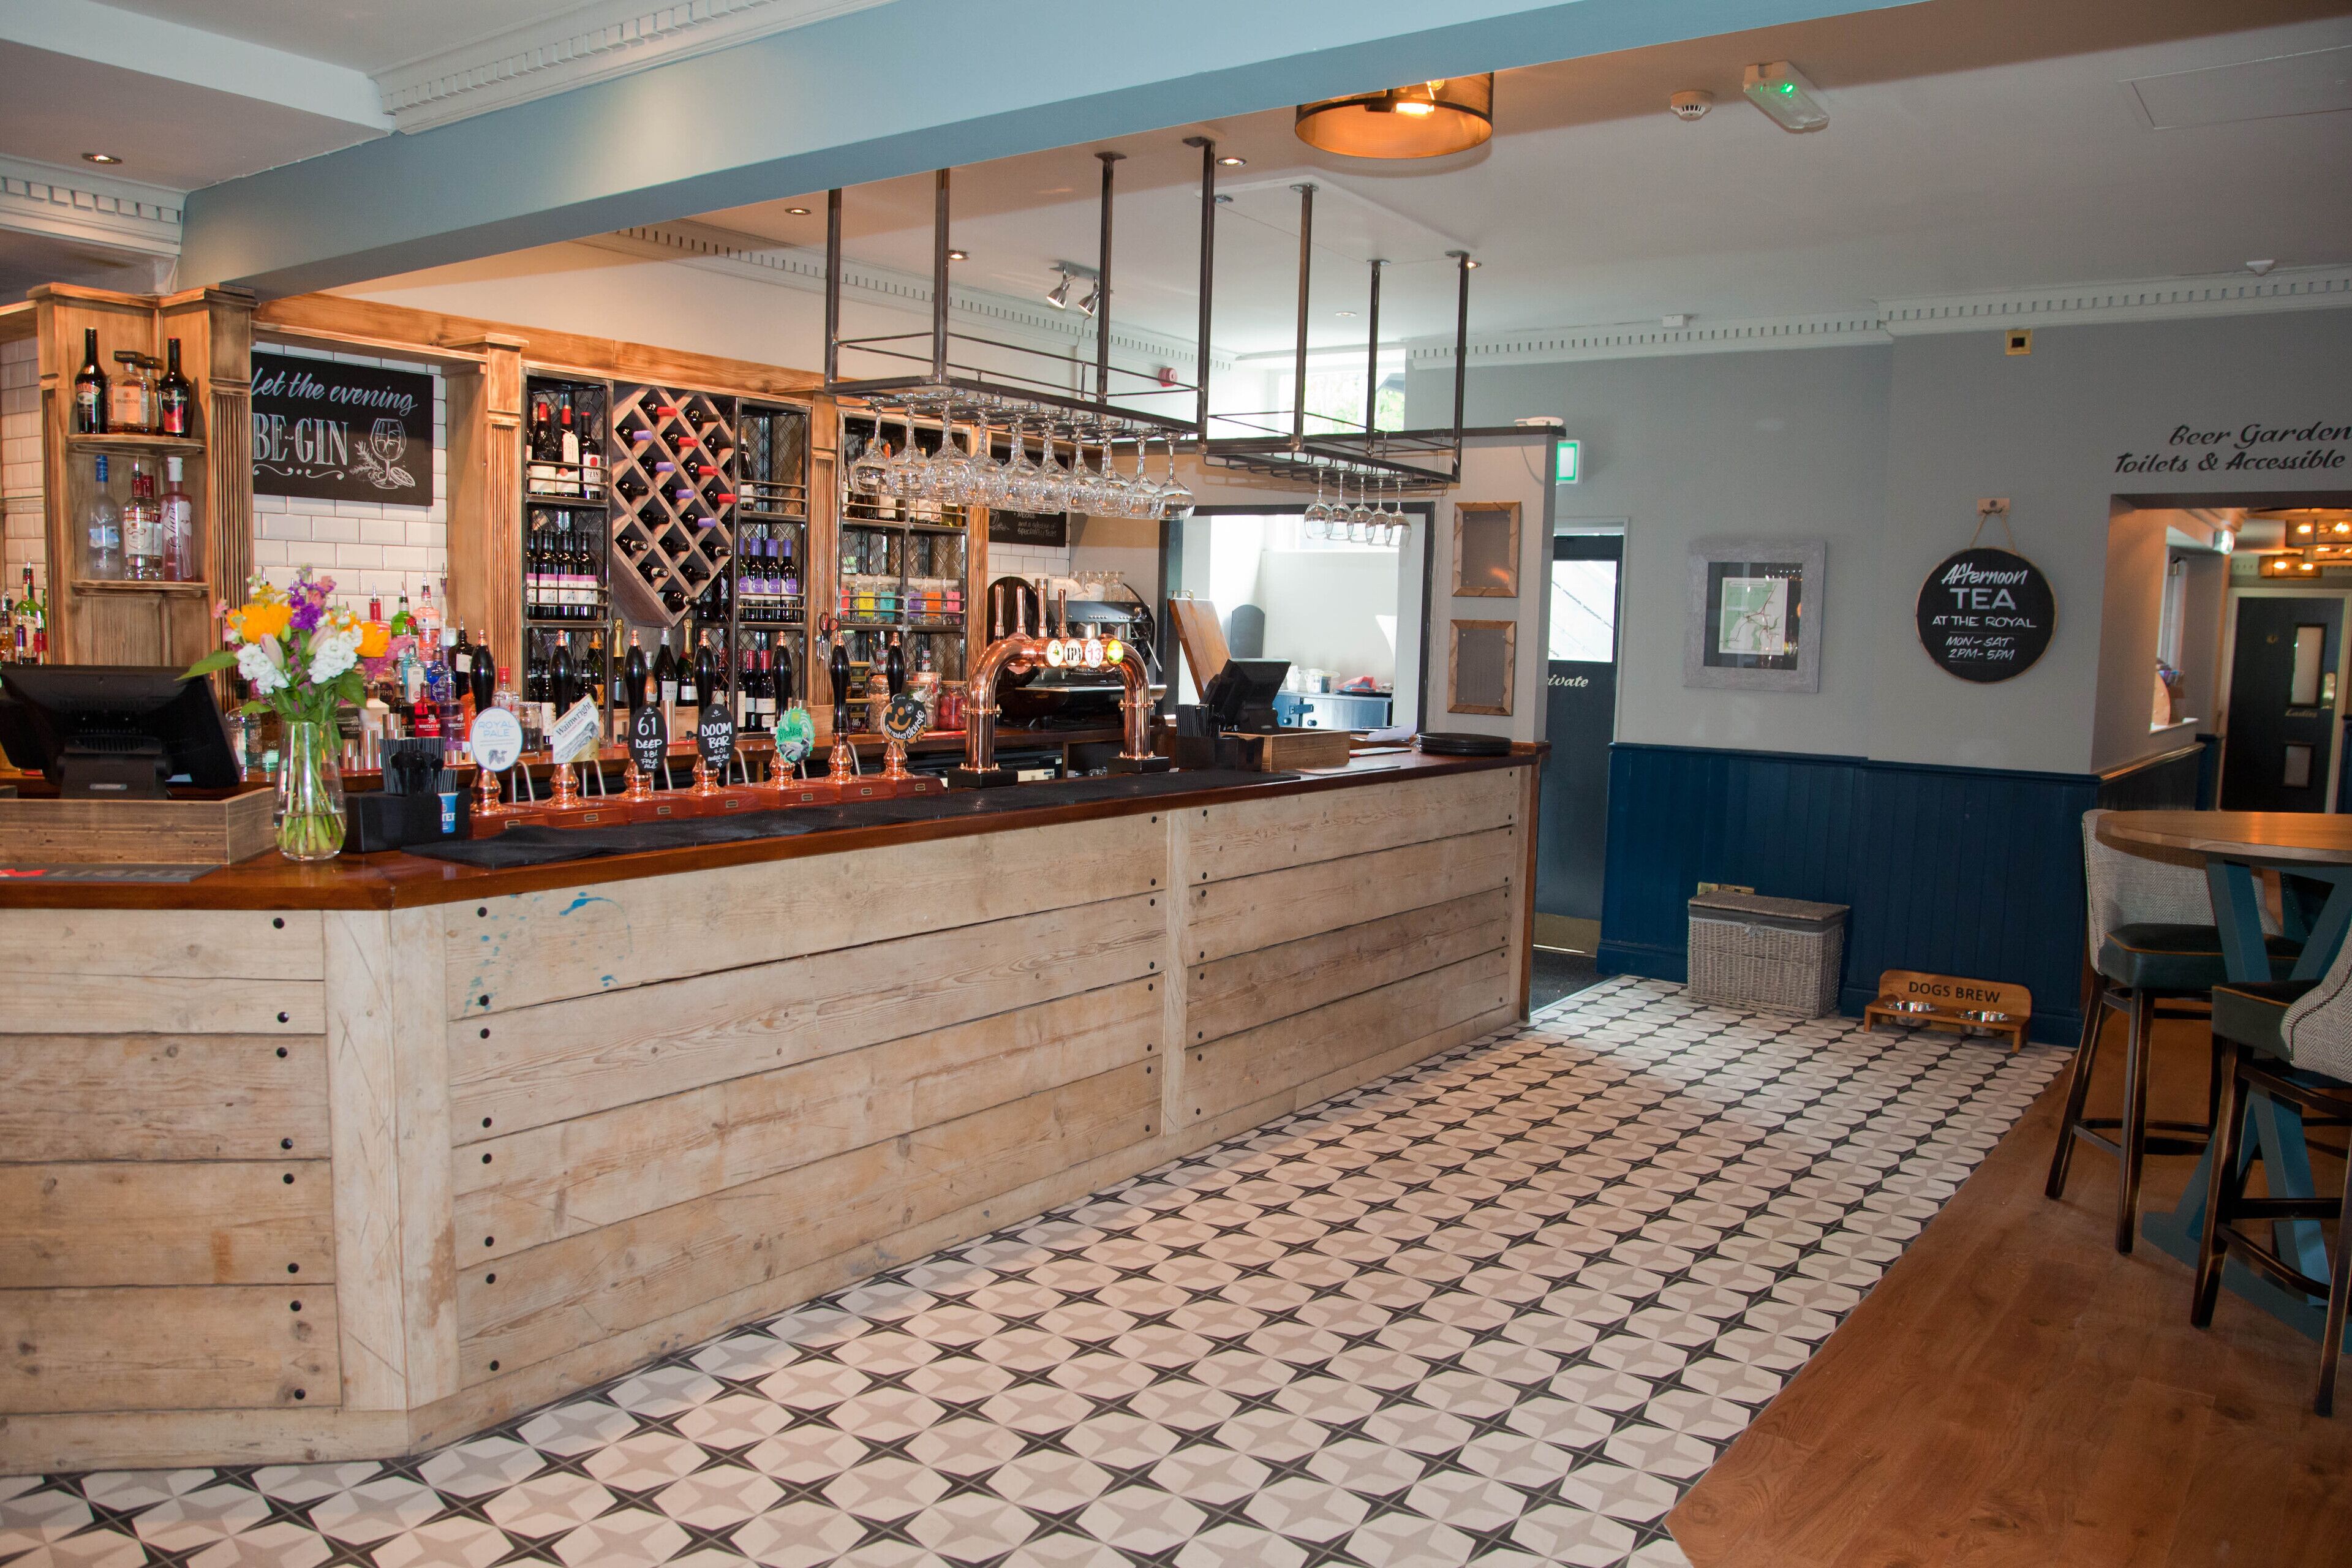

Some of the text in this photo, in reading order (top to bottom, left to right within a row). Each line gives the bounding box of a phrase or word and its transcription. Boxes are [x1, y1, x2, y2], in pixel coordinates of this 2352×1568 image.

[251, 368, 418, 417] Let the evening
[2169, 421, 2352, 450] Beer Garden
[2115, 449, 2346, 473] Toilets & Accessible
[1940, 562, 2028, 585] Afternoon
[1950, 588, 2016, 610] TEA
[1932, 616, 2037, 628] AT THE ROYAL
[1067, 647, 1081, 662] IPA
[1087, 647, 1101, 662] 13
[1547, 674, 1589, 688] ivate
[478, 720, 514, 729] ROYAL
[556, 701, 592, 736] Wainwright
[638, 716, 657, 736] 61
[483, 729, 510, 737] PALE
[701, 722, 733, 737] DOOM
[635, 738, 663, 748] DEEP
[707, 736, 731, 749] BAR
[1909, 981, 2000, 1003] DOGS BREW
